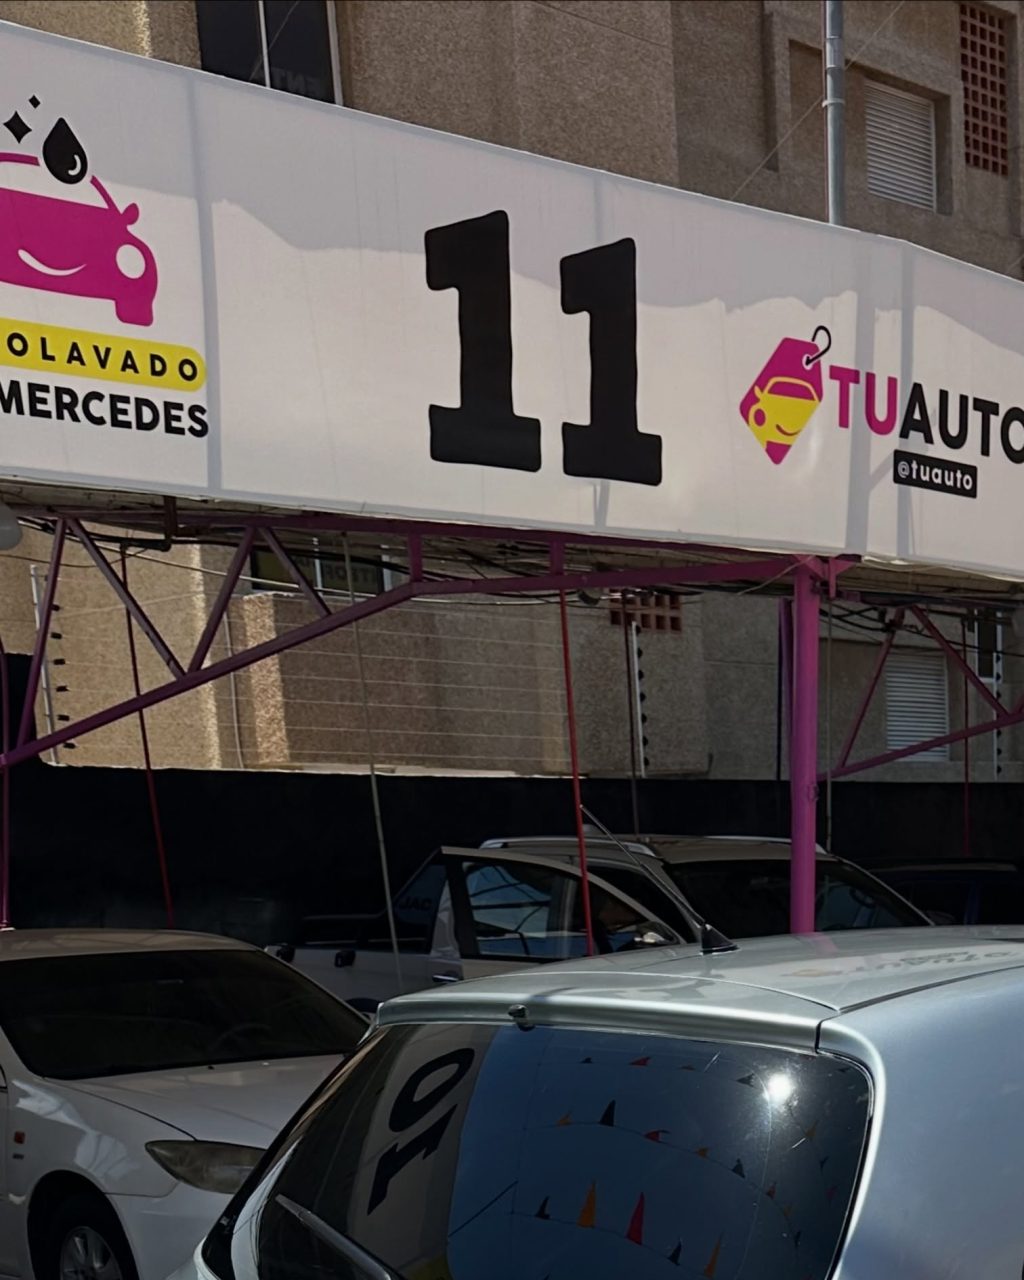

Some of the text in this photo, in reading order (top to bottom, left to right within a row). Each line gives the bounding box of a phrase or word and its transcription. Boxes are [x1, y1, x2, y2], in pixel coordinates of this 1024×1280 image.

[6, 332, 198, 381] OLAVADO
[424, 209, 662, 486] 11
[0, 379, 209, 438] MERCEDES
[896, 459, 974, 492] @tuauto
